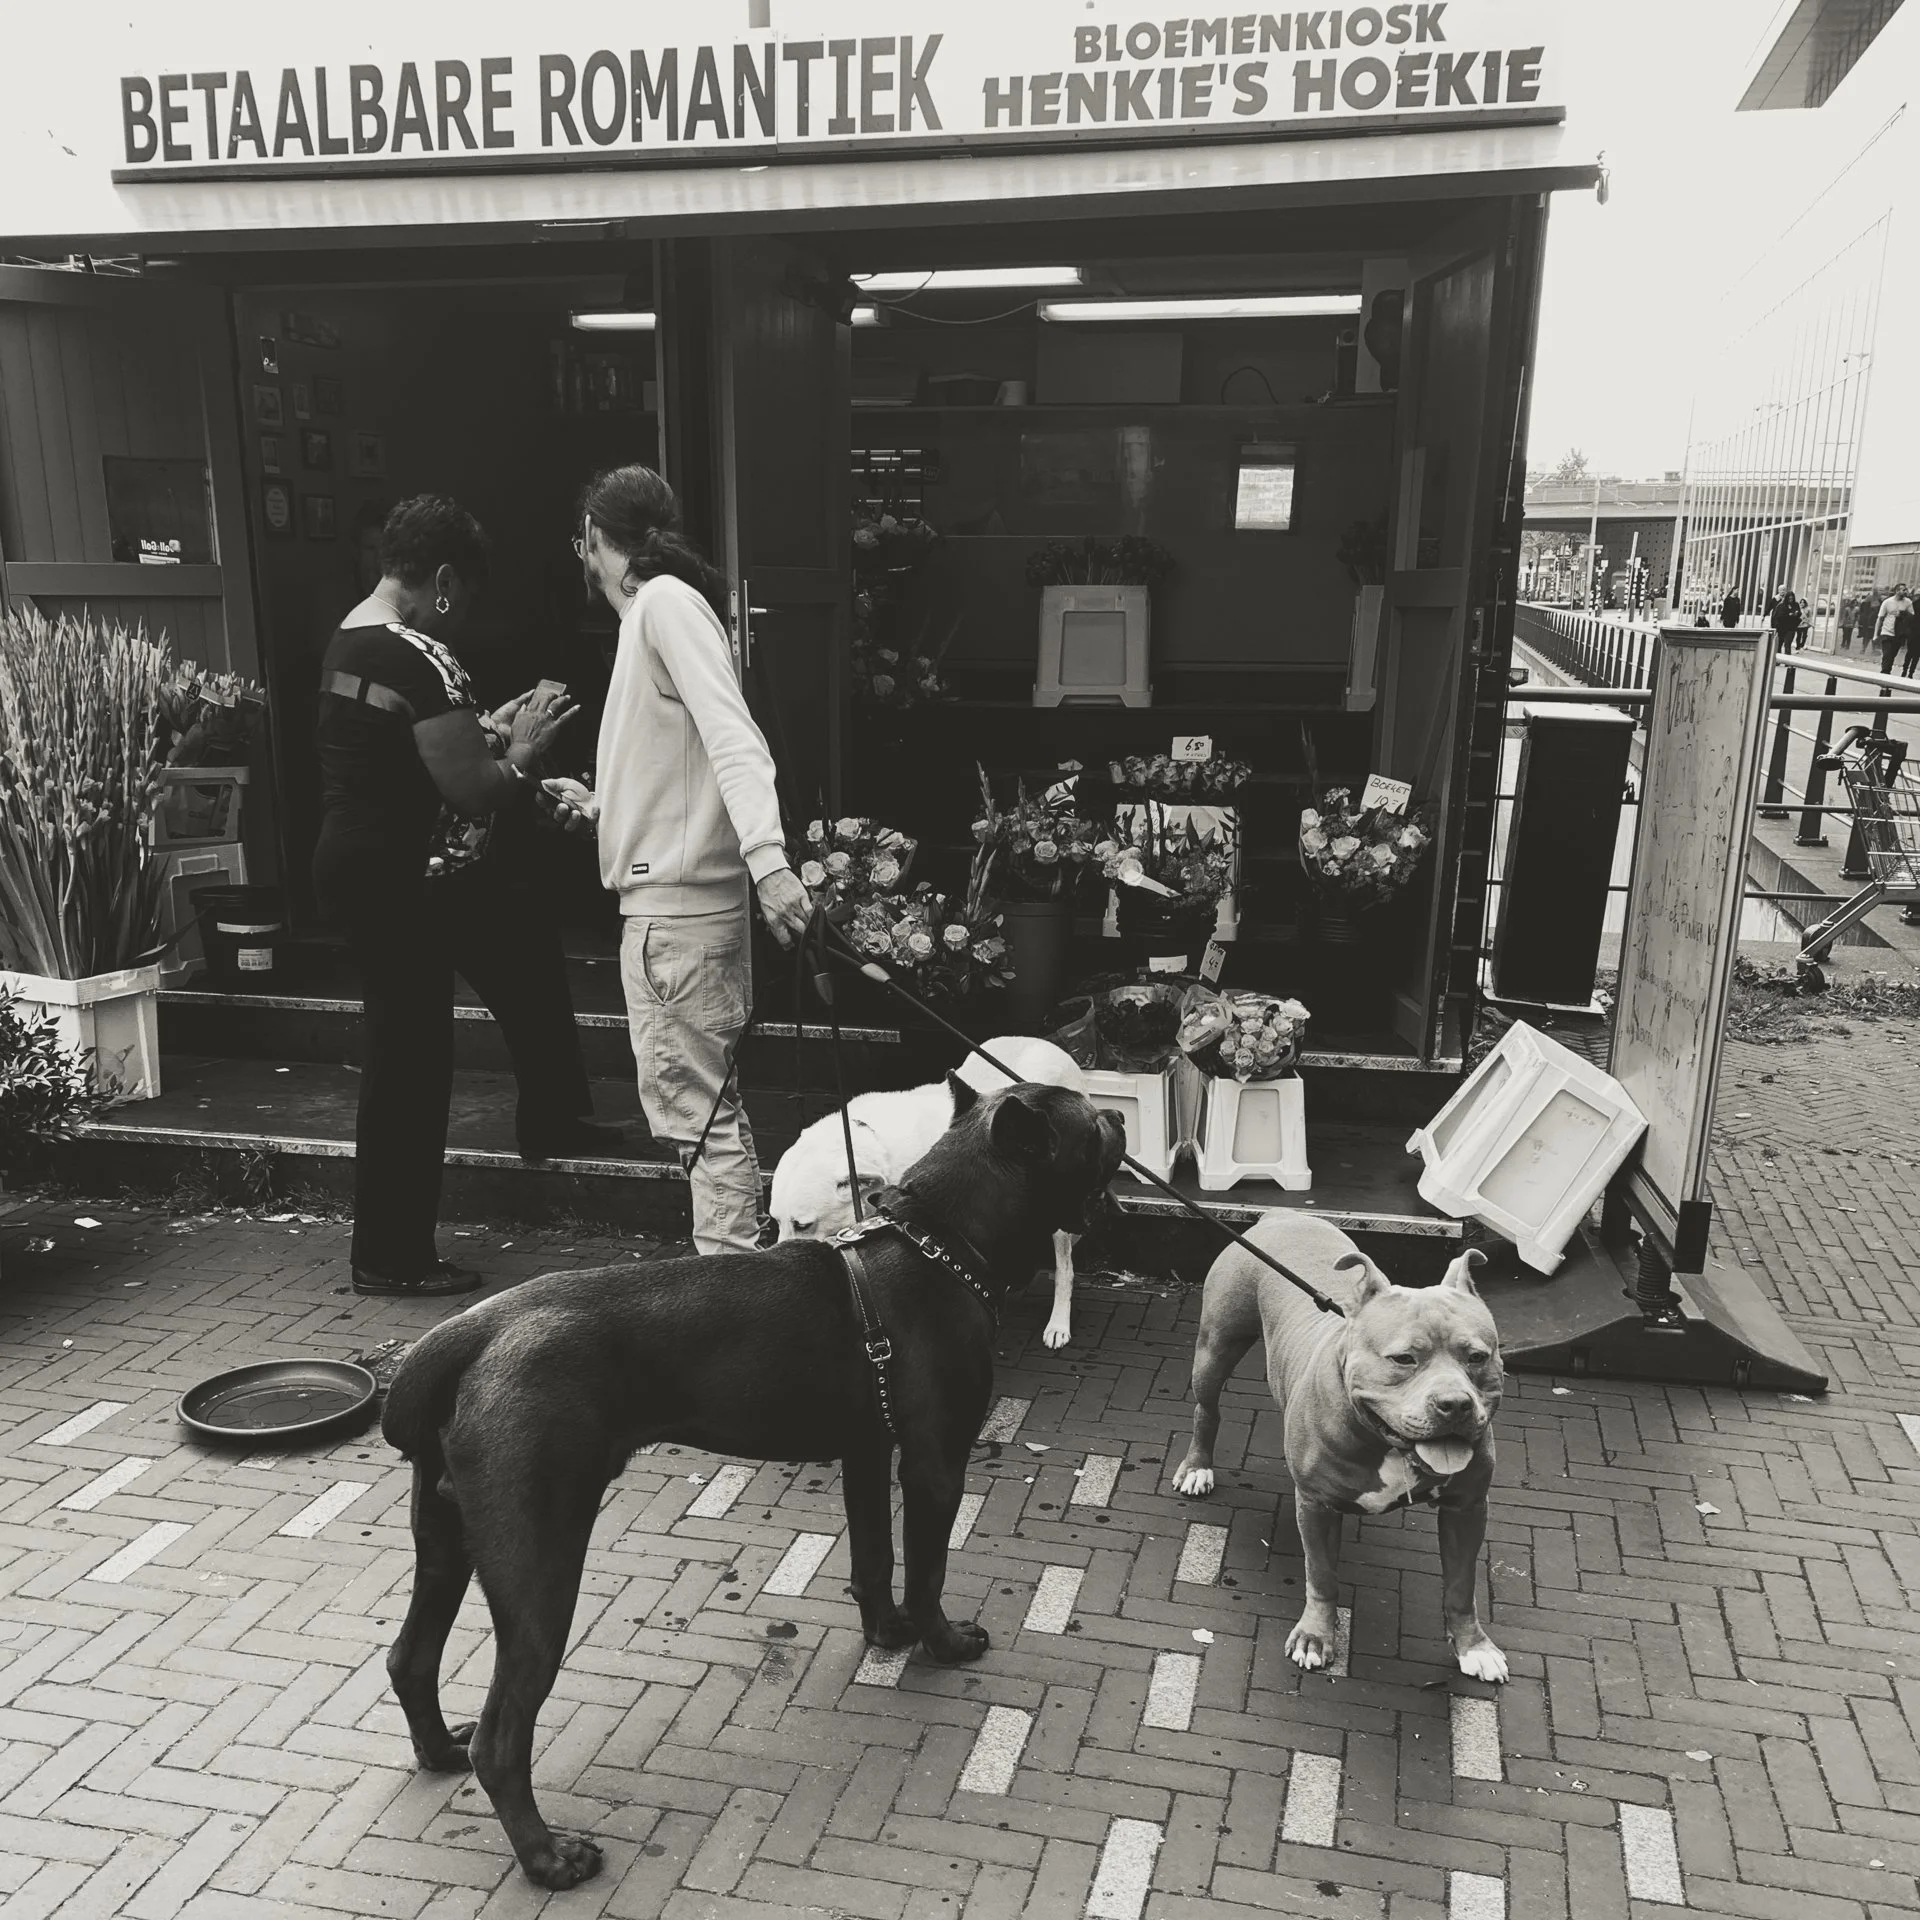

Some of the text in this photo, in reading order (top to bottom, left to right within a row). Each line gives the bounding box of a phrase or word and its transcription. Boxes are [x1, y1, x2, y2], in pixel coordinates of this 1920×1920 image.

[1074, 2, 1448, 64] BLOEMENKIOSK
[119, 33, 944, 164] BETAALBARE ROMANTIEK
[982, 46, 1545, 128] HENKIE'S HOEKIE
[1370, 777, 1410, 795] BOEKET
